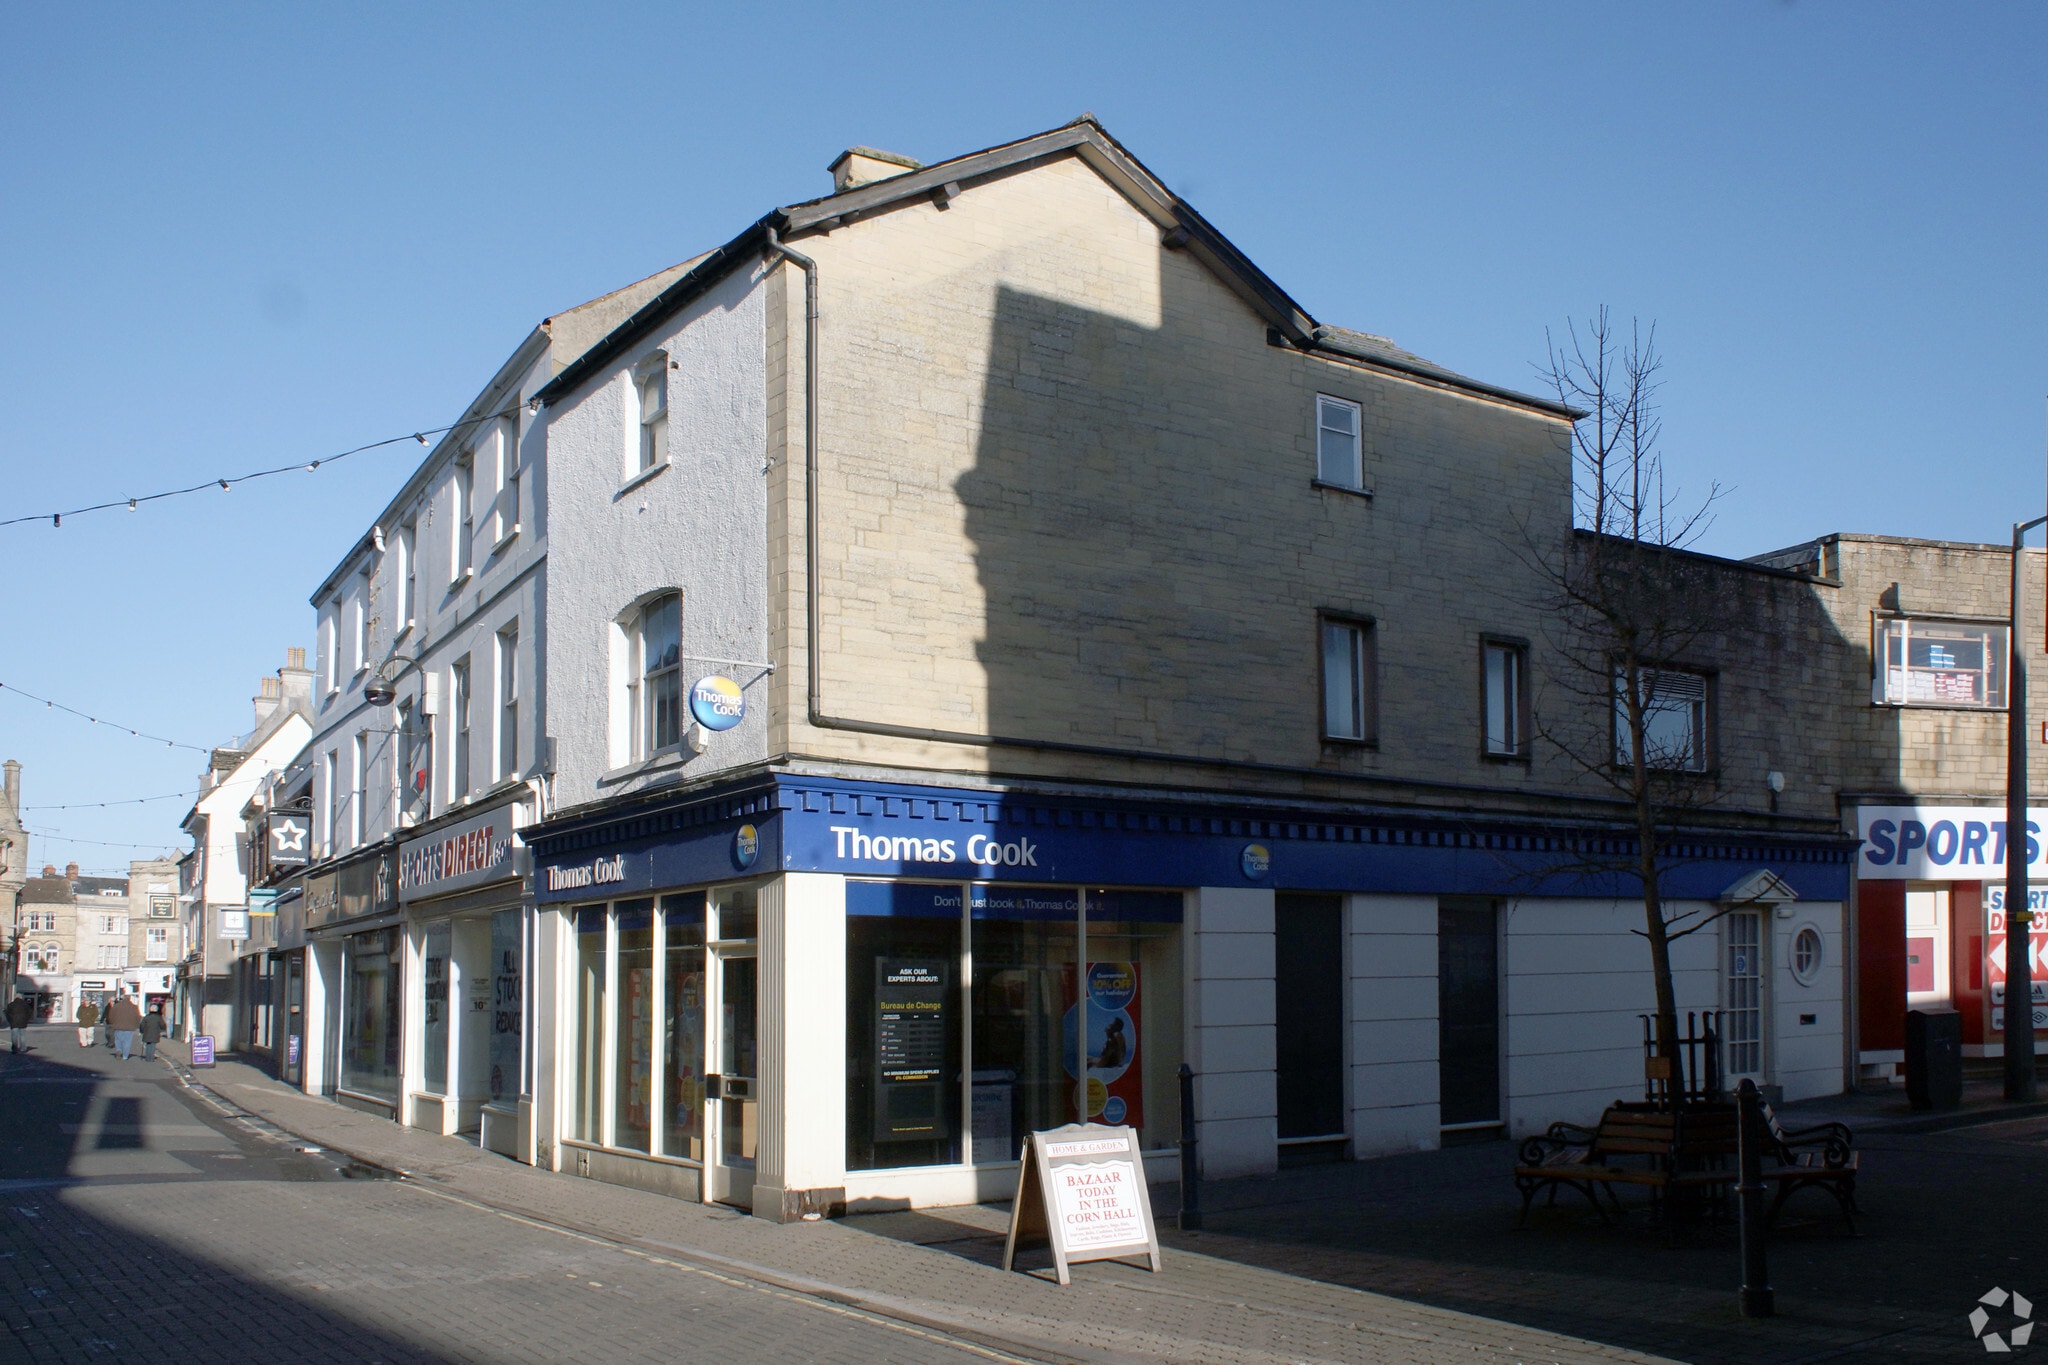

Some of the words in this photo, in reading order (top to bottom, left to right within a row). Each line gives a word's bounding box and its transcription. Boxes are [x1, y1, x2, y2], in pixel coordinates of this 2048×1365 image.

[695, 689, 743, 706] Thomas
[713, 703, 743, 717] Cook
[737, 837, 756, 847] Thomas
[830, 826, 956, 863] Thomas
[967, 834, 1038, 867] Cook
[1865, 819, 2041, 866] SPORTS
[744, 845, 756, 855] Cook
[1243, 853, 1269, 863] Thomas
[546, 865, 592, 891] Thomas
[594, 854, 625, 884] Cook
[1252, 862, 1269, 870] Cook
[934, 895, 961, 907] Don't
[989, 897, 1015, 908] book
[1024, 898, 1063, 911] Thomas
[502, 950, 518, 973] ALL
[887, 975, 916, 983] EXPERTS
[916, 975, 939, 983] ABOUT:
[916, 1002, 941, 1010] Change
[1052, 1145, 1078, 1154] HOME
[1088, 1141, 1124, 1152] GARDEN
[1066, 1171, 1122, 1187] BAZAAR
[1076, 1186, 1116, 1198] TODAY
[1079, 1200, 1092, 1210] IN
[1094, 1197, 1119, 1208] THE
[1067, 1211, 1101, 1224] CORN
[1103, 1208, 1136, 1220] HALL
